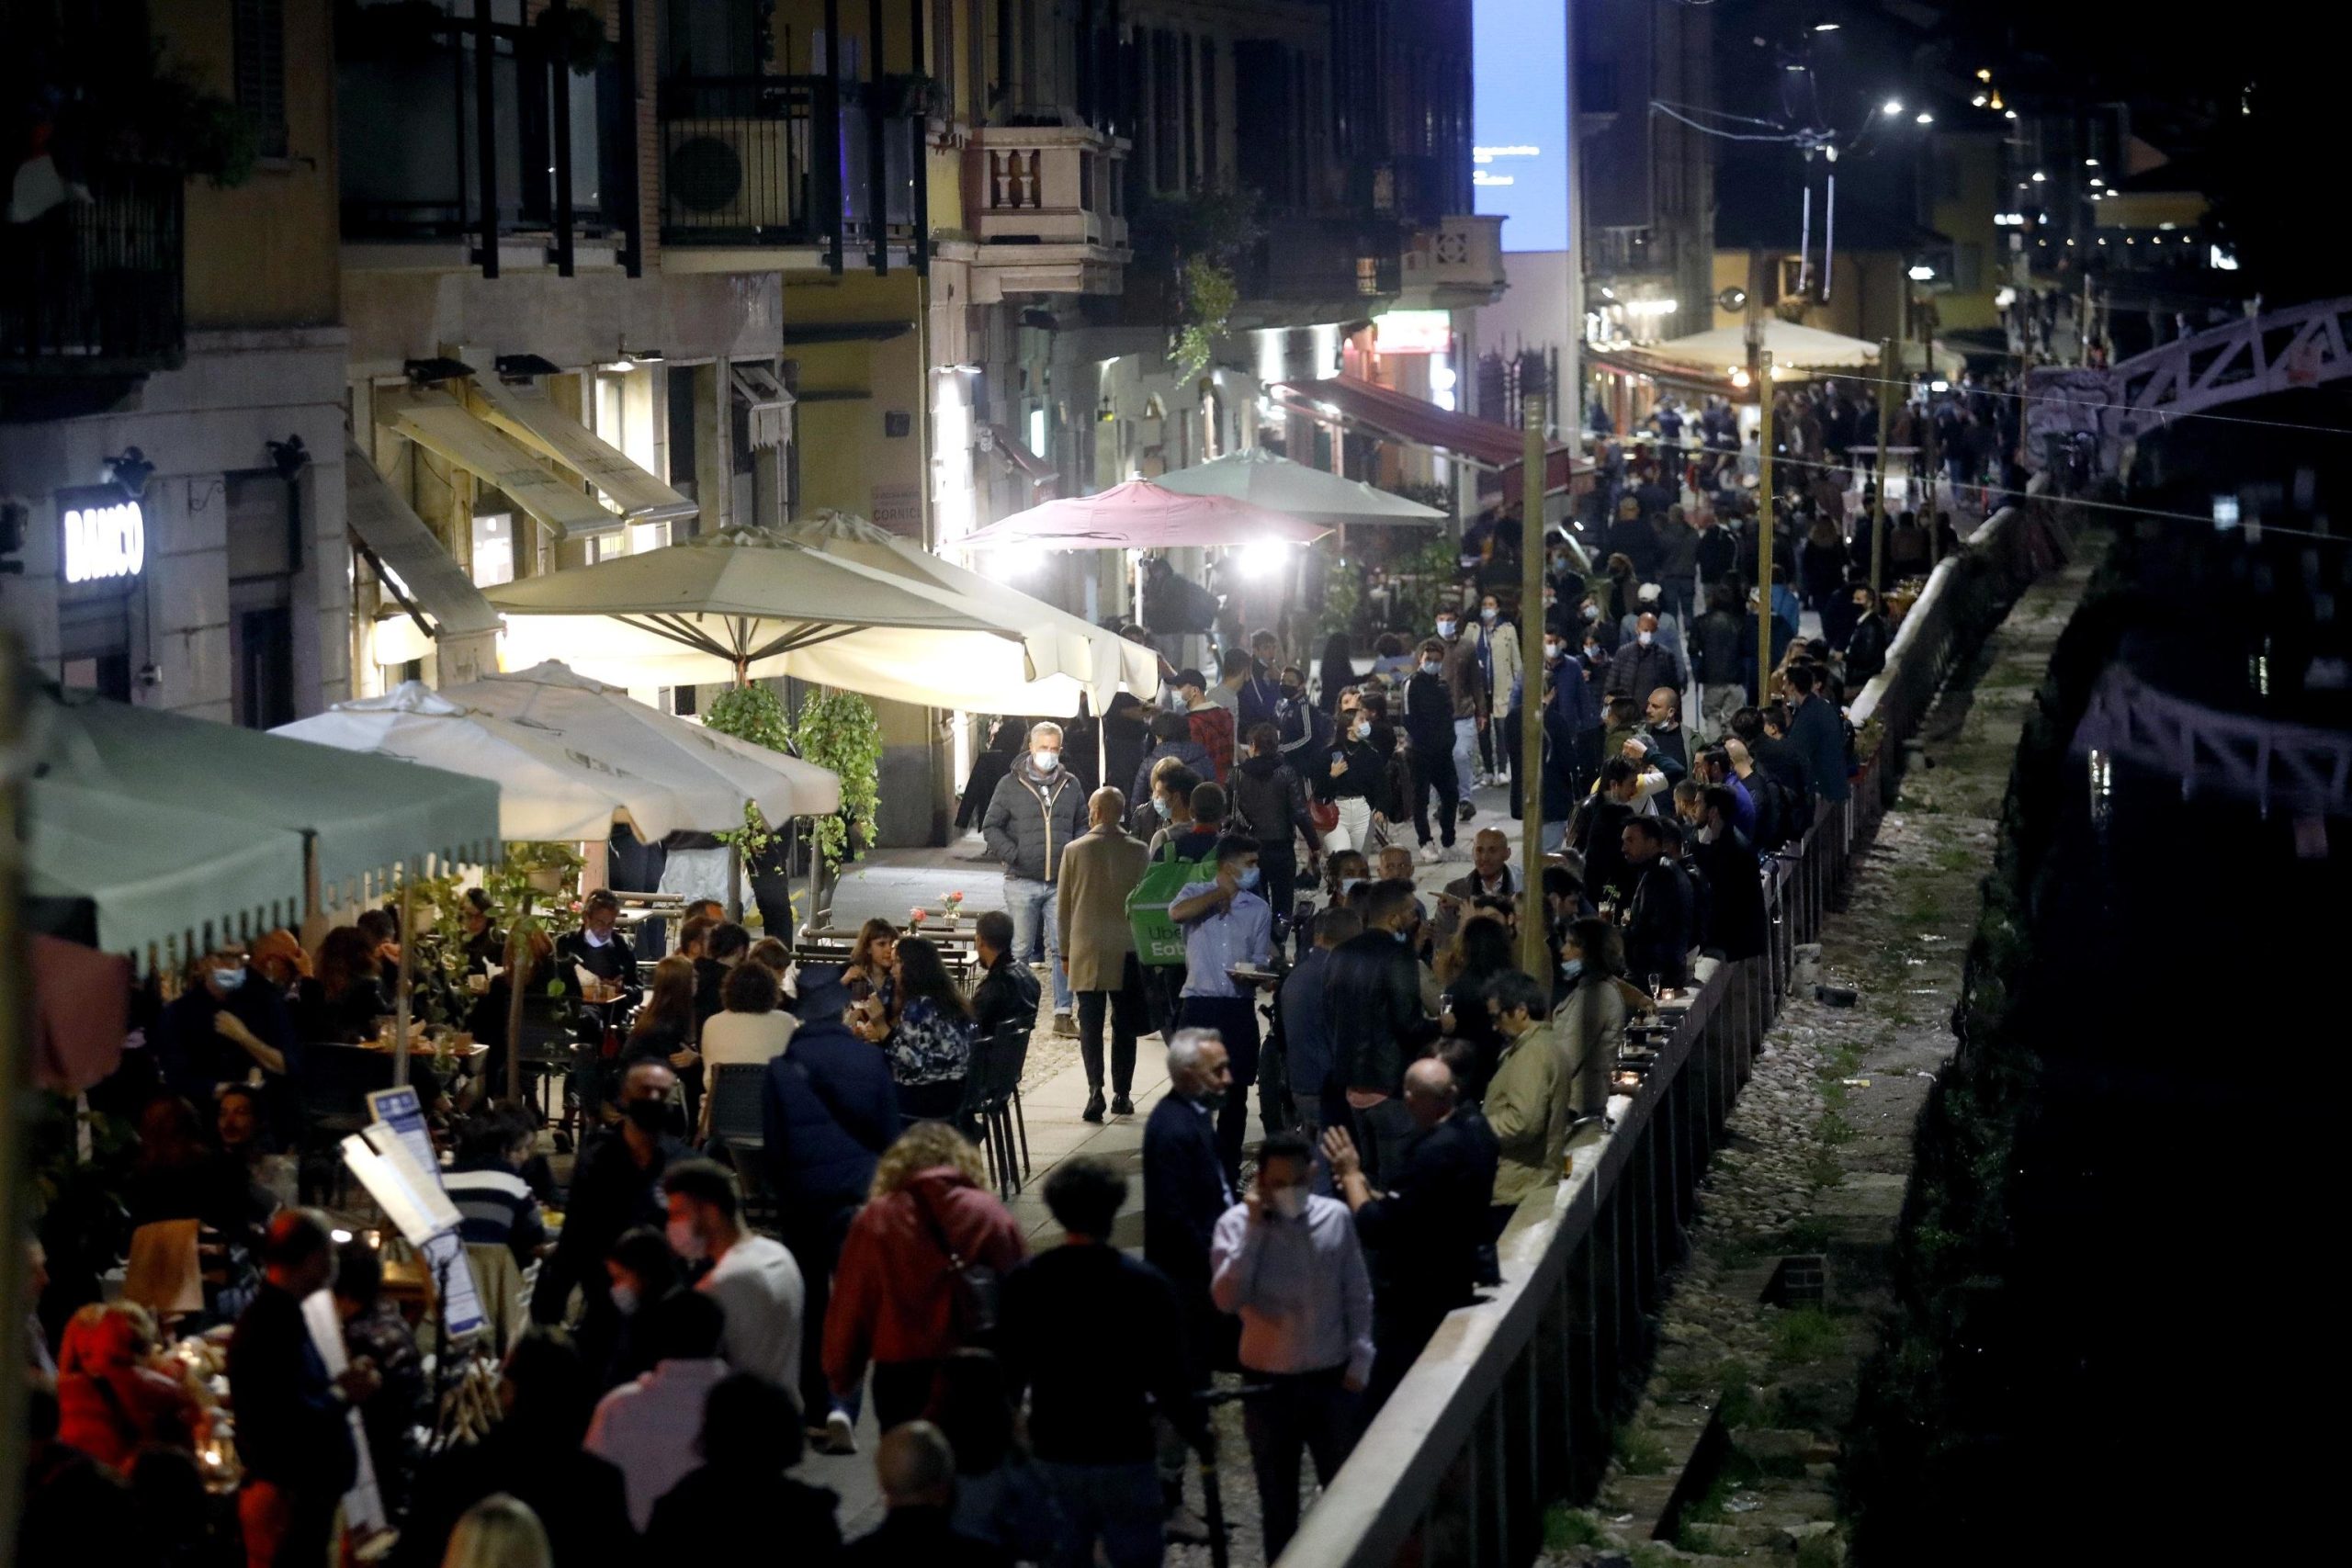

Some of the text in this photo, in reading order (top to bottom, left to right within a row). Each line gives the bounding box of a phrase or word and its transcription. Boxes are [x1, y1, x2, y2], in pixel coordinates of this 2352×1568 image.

[64, 501, 145, 582] BANCO
[1148, 925, 1182, 941] Ube
[1151, 942, 1185, 956] Eat
